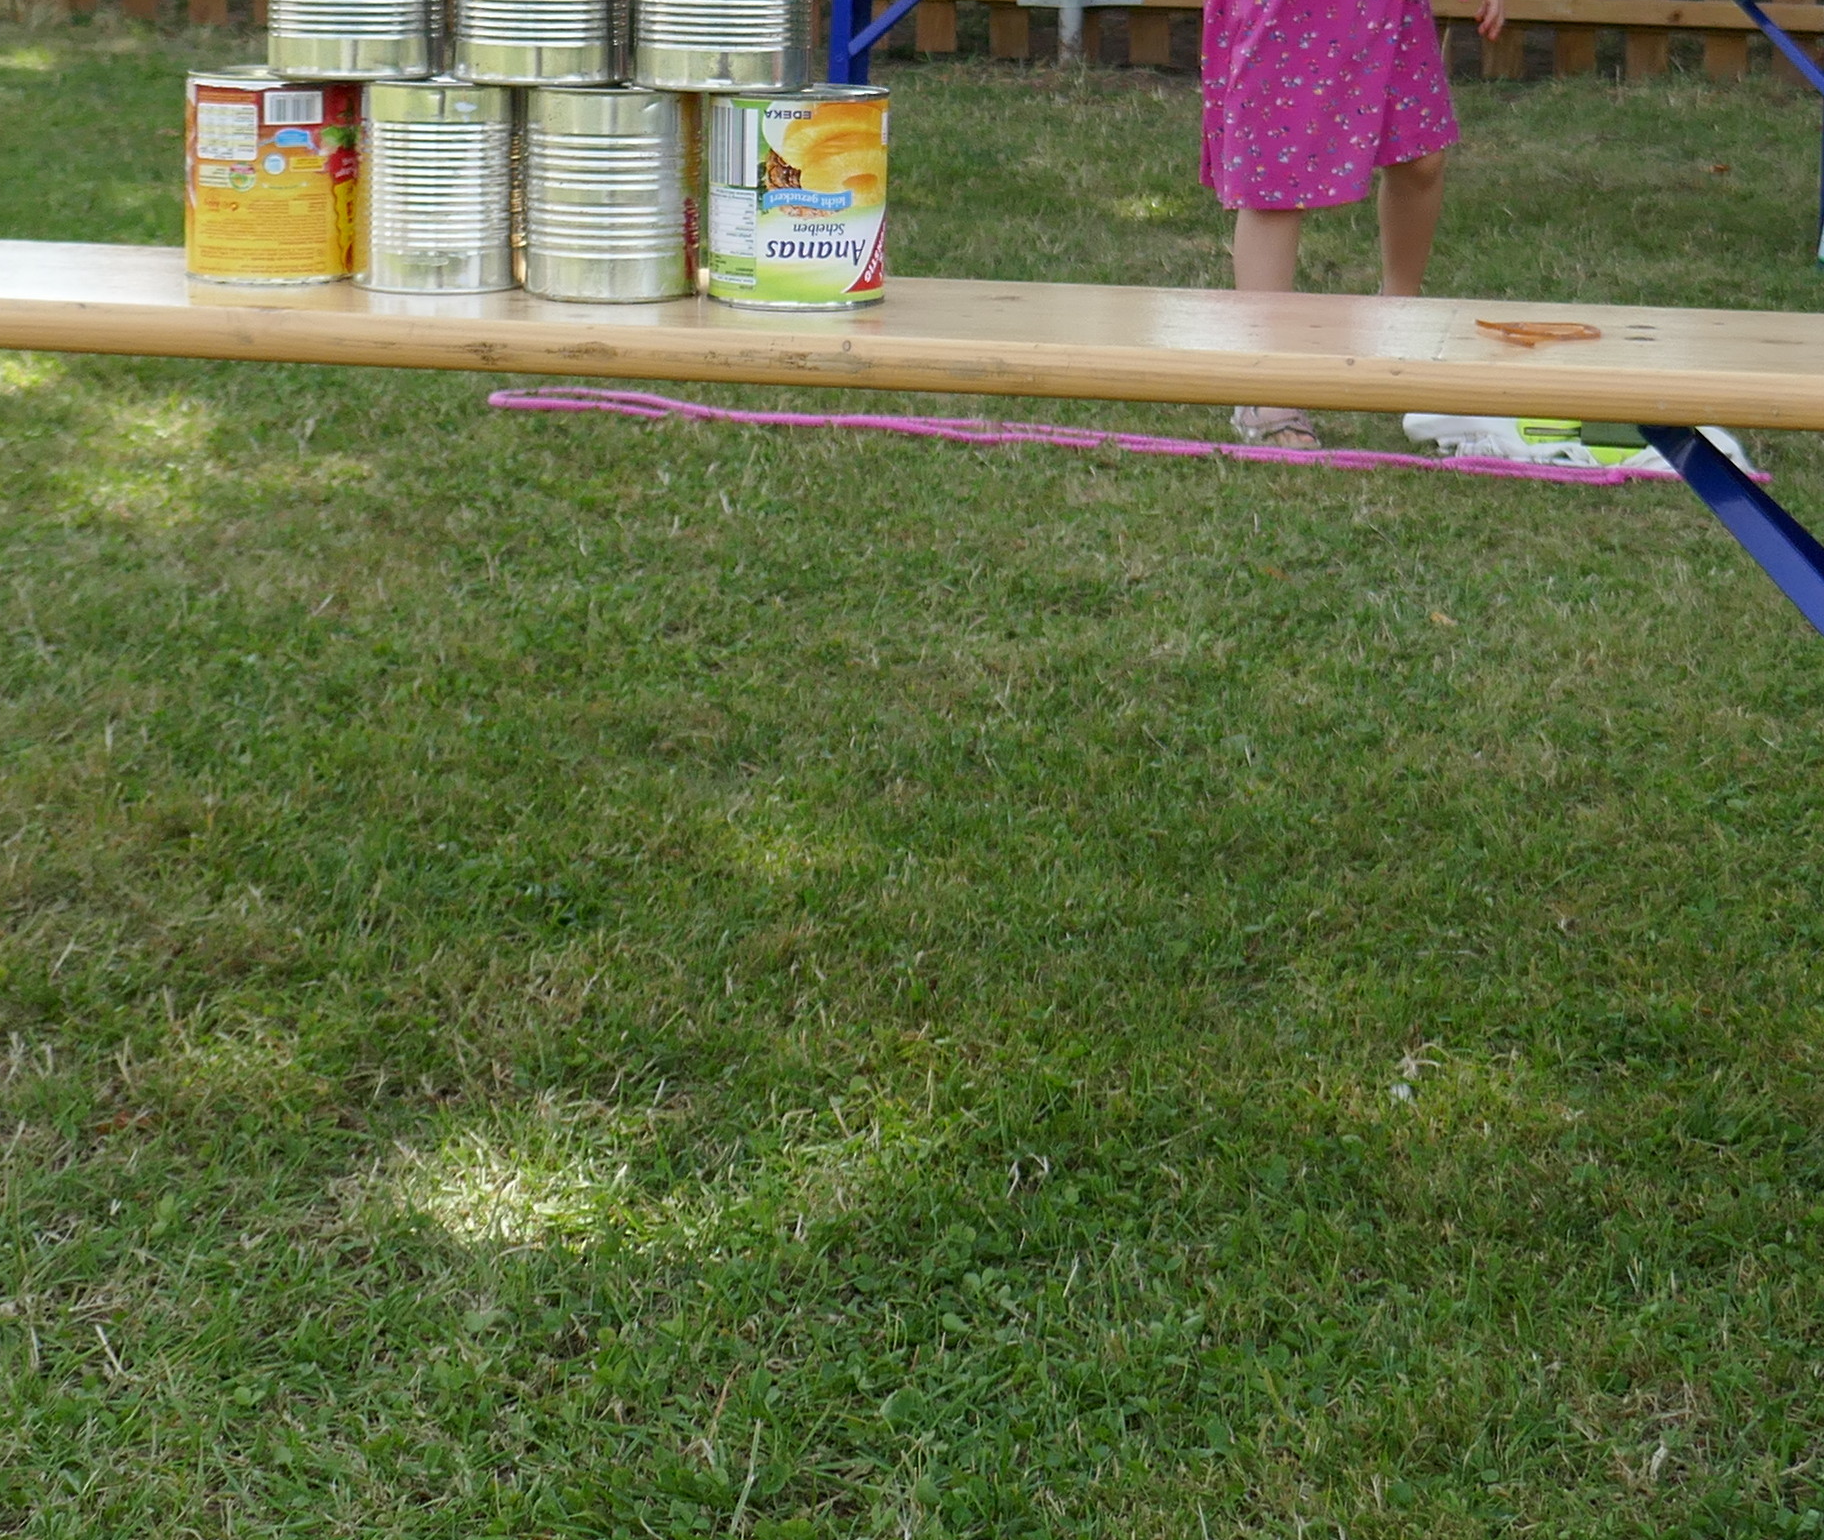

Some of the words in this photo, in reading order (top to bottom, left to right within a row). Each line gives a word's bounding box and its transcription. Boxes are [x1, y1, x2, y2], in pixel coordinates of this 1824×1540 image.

[766, 110, 812, 119] EDEKA
[770, 193, 819, 206] gezuckert
[821, 195, 846, 208] leicht
[793, 223, 845, 236] Scheiben
[766, 238, 866, 266] Ananas
